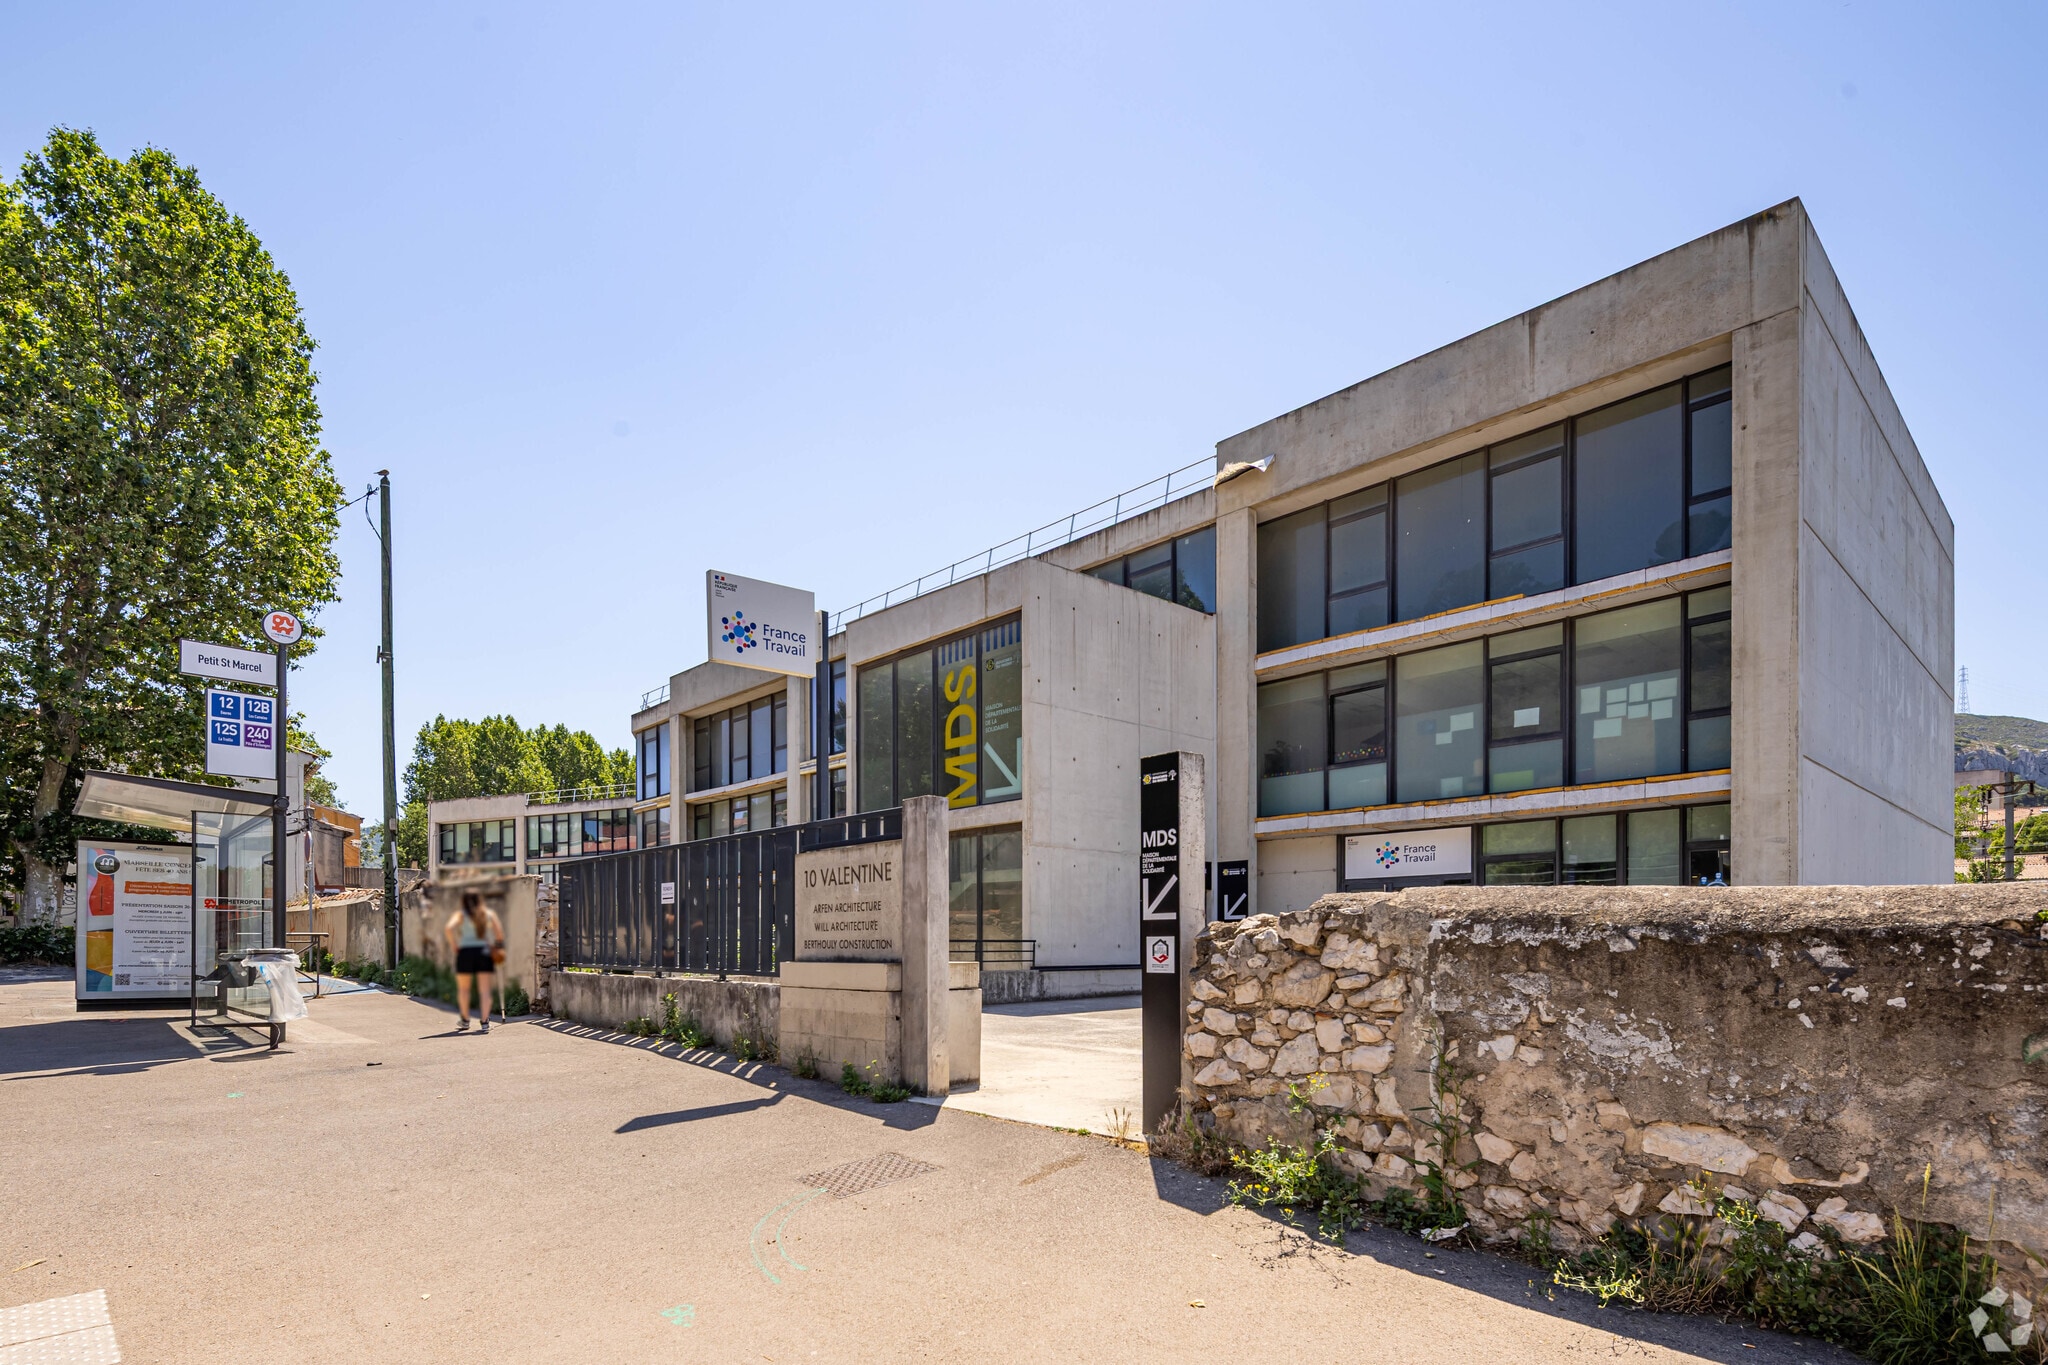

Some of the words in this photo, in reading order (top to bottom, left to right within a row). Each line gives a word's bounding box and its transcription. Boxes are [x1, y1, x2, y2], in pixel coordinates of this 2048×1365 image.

[763, 624, 806, 643] France
[763, 637, 806, 657] Travail
[198, 654, 218, 666] Petit
[221, 658, 231, 668] St
[233, 660, 262, 672] Marcel
[219, 696, 234, 709] 12
[247, 700, 270, 714] 12B
[985, 702, 1003, 711] MAISON
[984, 705, 1022, 719] DÉPARTEMENTALE
[215, 722, 238, 736] 12S
[247, 726, 269, 740] 240
[985, 721, 1009, 734] SOLIDARITÉ
[944, 664, 977, 810] MDS
[1143, 828, 1177, 848] MDS
[1404, 844, 1436, 854] France
[124, 860, 163, 868] MARSEILLE
[1142, 855, 1177, 863] DÉPARTEMENTALE
[1404, 852, 1436, 863] Travail
[804, 869, 817, 888] 10
[820, 862, 892, 887] VALENTINE
[1142, 866, 1165, 874] SOLIDARITÉ
[813, 904, 833, 913] ARFEN
[834, 901, 882, 912] ARCHITECTURE
[814, 922, 829, 932] WILL
[830, 920, 878, 931] ARCHITECTURE
[804, 940, 837, 950] BERTHOULY
[839, 939, 893, 950] CONSTRUCTION
